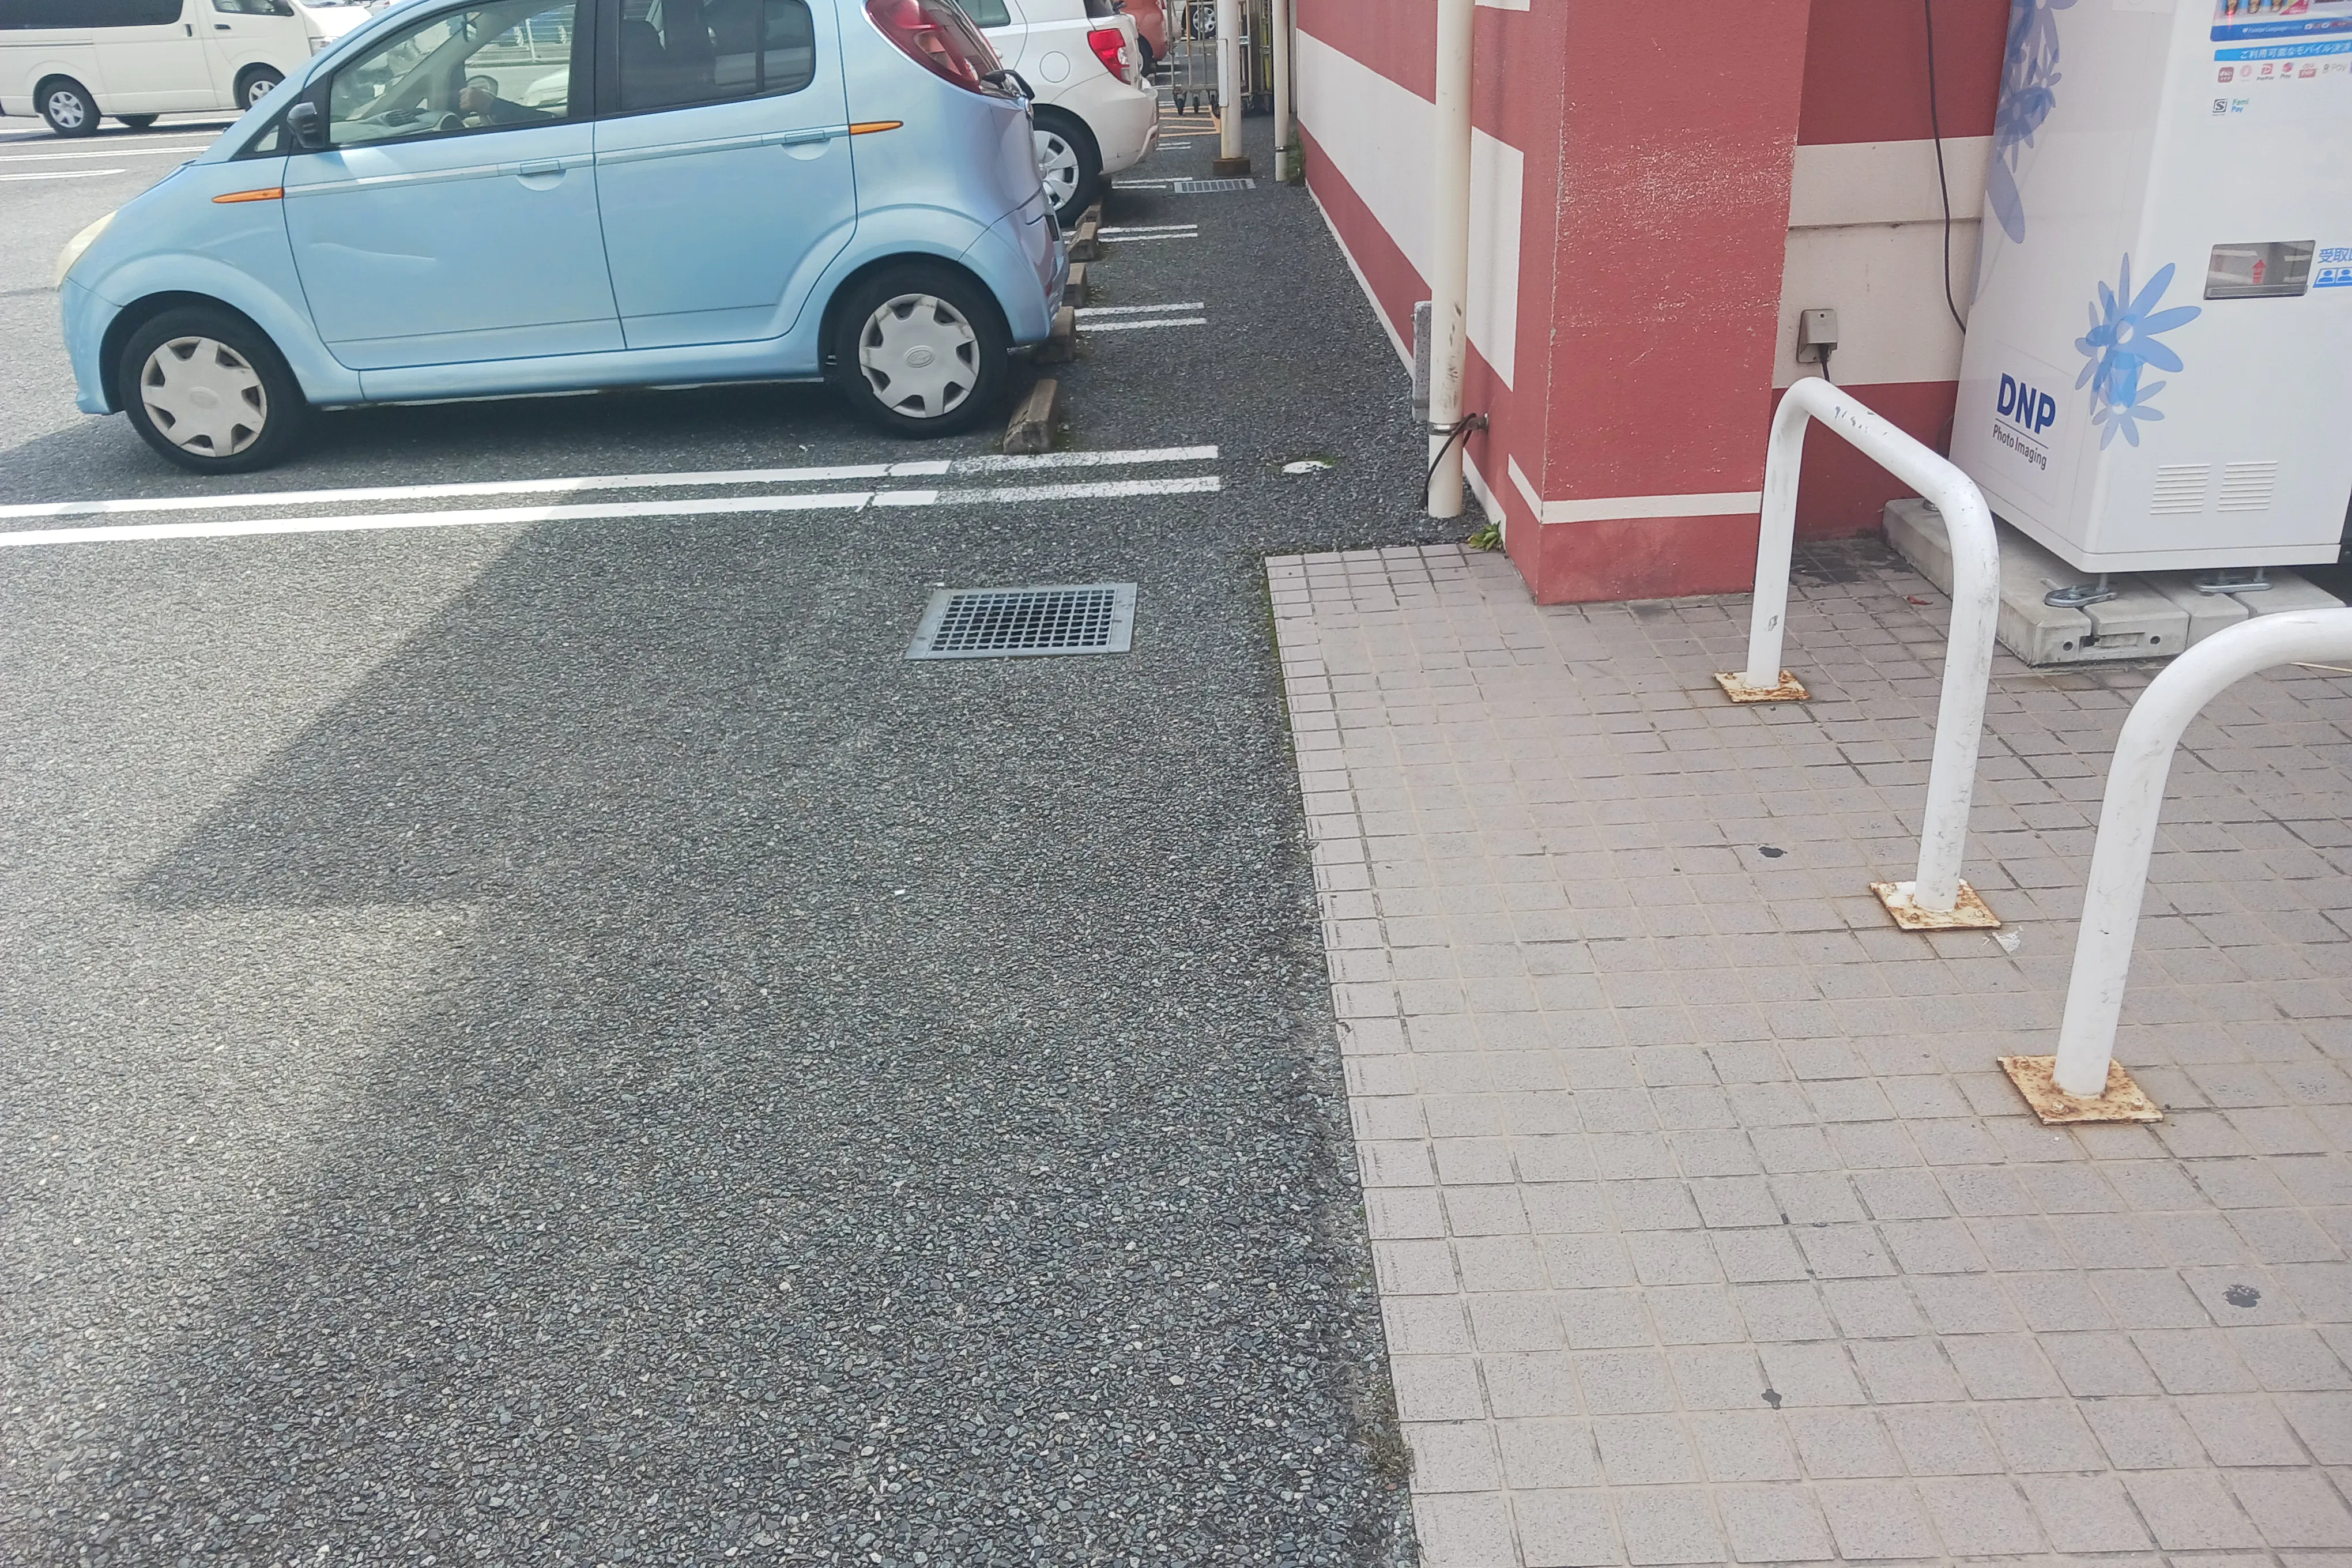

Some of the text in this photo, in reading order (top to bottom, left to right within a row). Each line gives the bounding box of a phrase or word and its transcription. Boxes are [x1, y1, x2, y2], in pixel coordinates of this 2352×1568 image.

[2317, 247, 2352, 263] 受取
[1997, 372, 2056, 434] DNP
[1992, 424, 2047, 470] Photo Imaging
